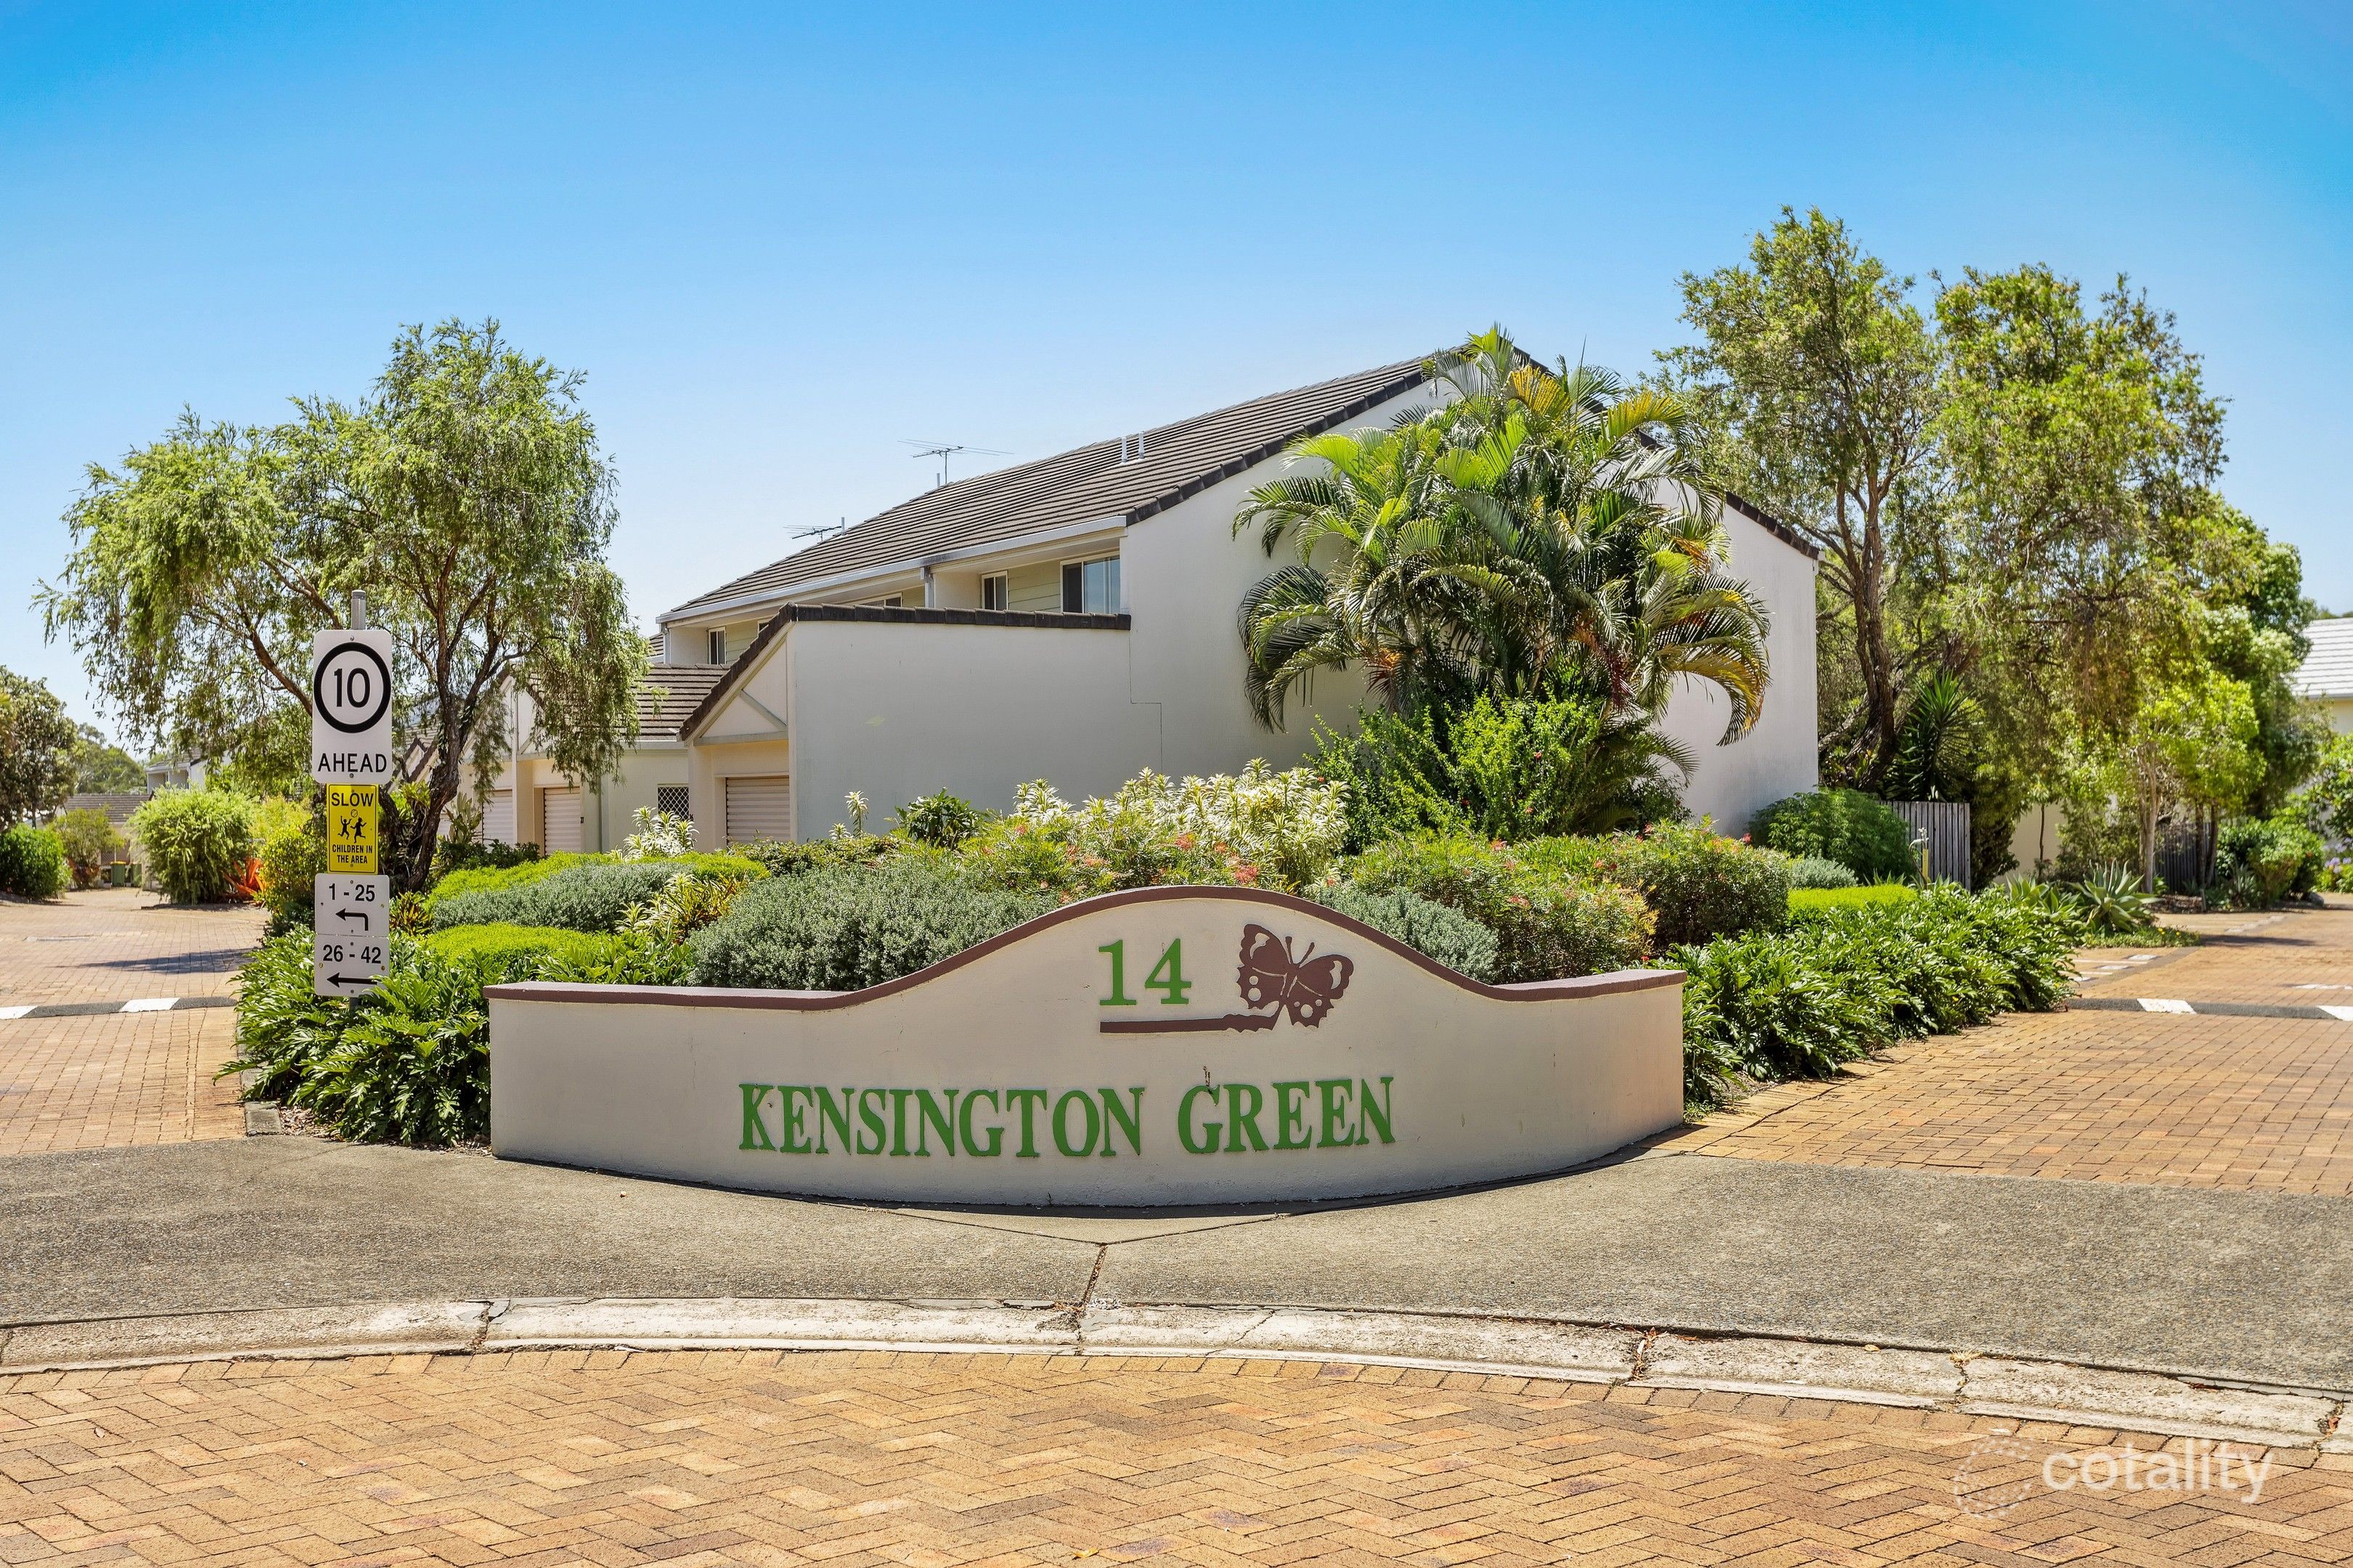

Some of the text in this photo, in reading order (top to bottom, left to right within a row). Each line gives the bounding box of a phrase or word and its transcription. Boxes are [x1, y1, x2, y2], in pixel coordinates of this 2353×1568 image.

[334, 668, 370, 708] 10
[318, 753, 387, 773] AHEAD
[331, 792, 374, 807] SLOW
[332, 844, 372, 854] CHILDREN IN
[337, 854, 367, 864] THE AREA
[329, 883, 335, 900] 1
[355, 884, 375, 902] 25
[323, 944, 343, 962] 26
[361, 946, 381, 964] 42
[1098, 937, 1191, 1006] 14
[738, 1076, 1395, 1158] KENSINGTON GREEN
